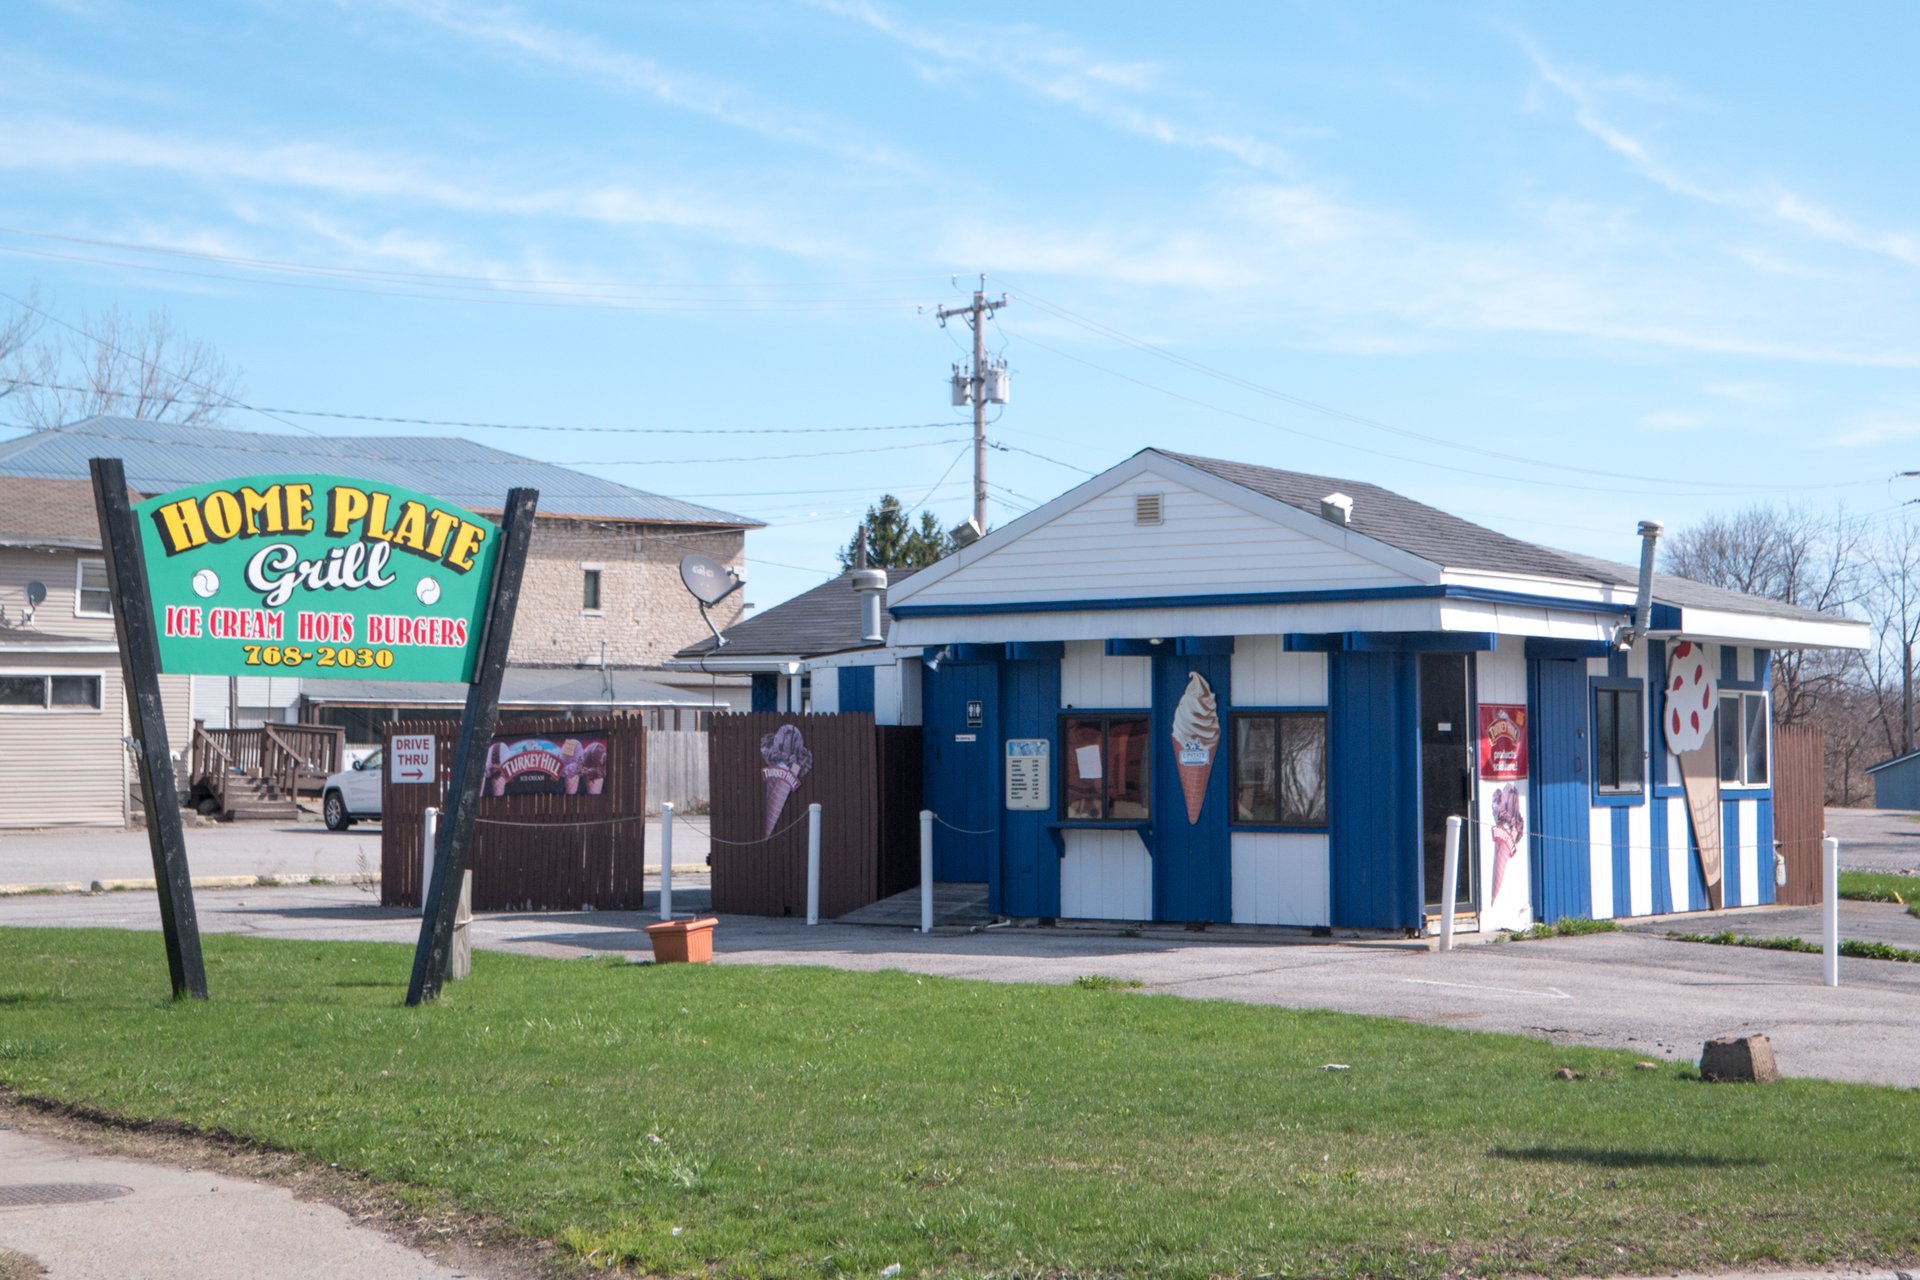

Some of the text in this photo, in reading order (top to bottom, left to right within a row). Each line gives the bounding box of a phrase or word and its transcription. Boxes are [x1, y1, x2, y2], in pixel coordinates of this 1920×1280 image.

[153, 483, 486, 574] HOME PLATE
[244, 541, 396, 608] Grill
[165, 606, 467, 647] ICE CREAM HOTS BURGERS
[243, 645, 394, 669] 768-2030
[396, 738, 430, 750] DRIVE
[398, 754, 429, 766] THRU
[502, 753, 561, 777] TURKEY HILL
